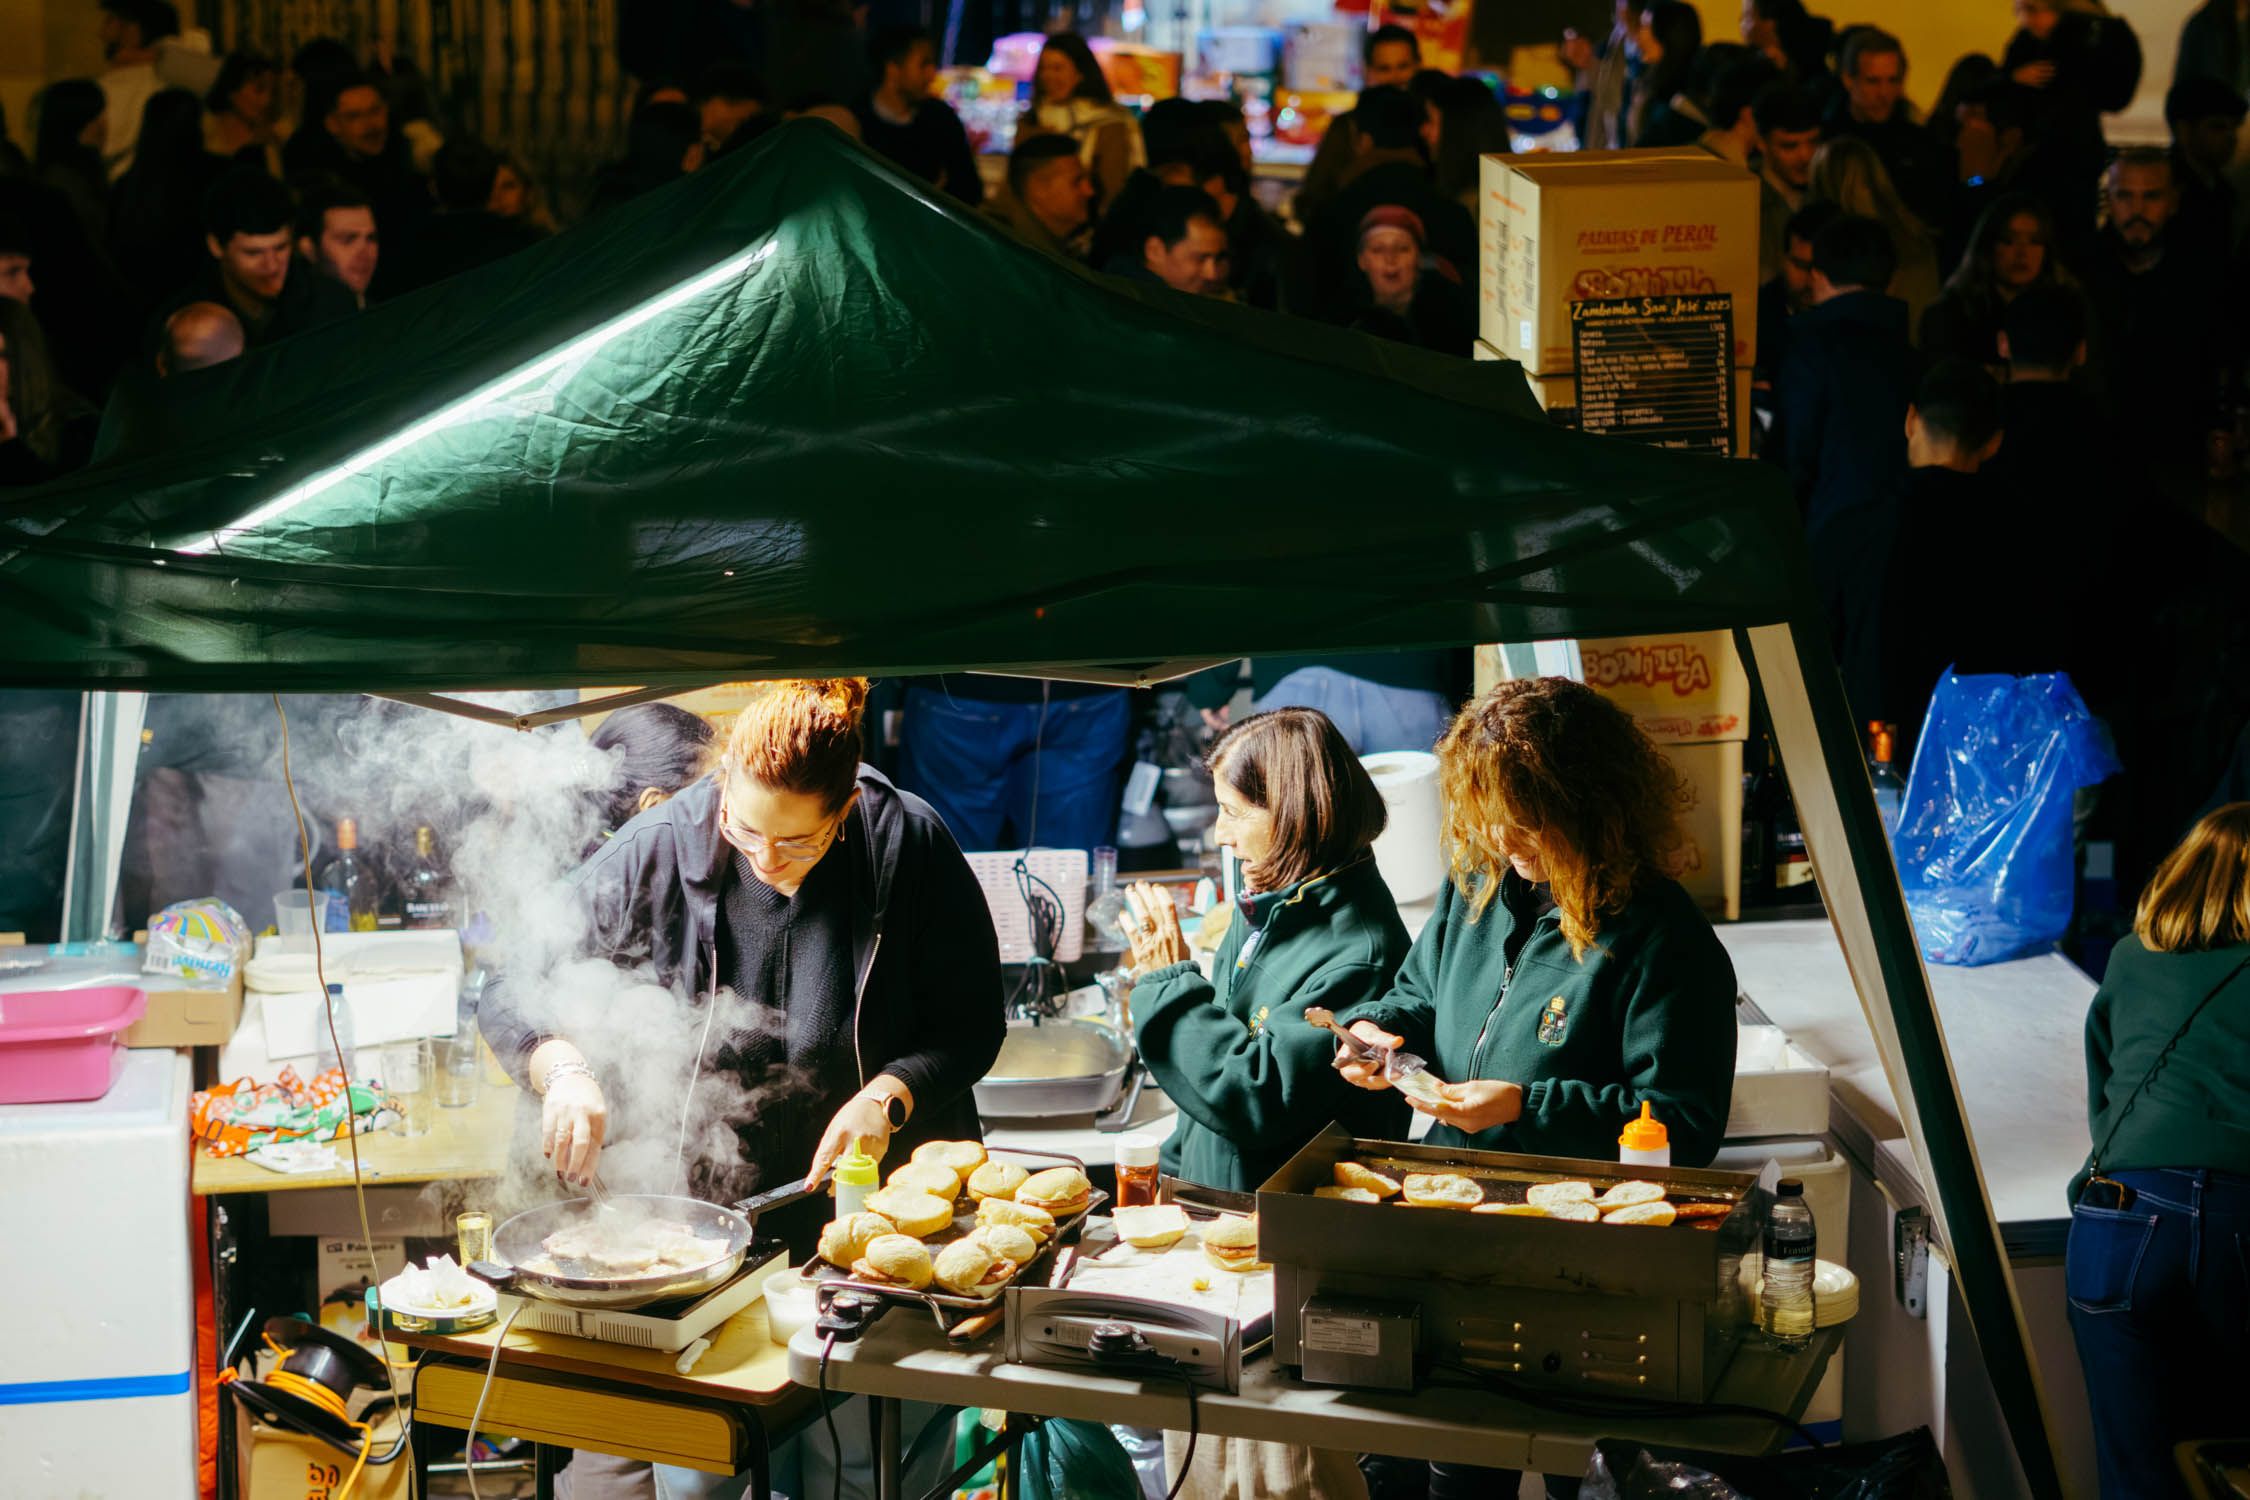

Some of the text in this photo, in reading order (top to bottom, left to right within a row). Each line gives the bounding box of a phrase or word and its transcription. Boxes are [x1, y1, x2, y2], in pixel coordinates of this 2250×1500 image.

[1663, 224, 1719, 243] PEROL
[1641, 298, 1667, 317] San
[1582, 644, 1711, 697] BONILLA
